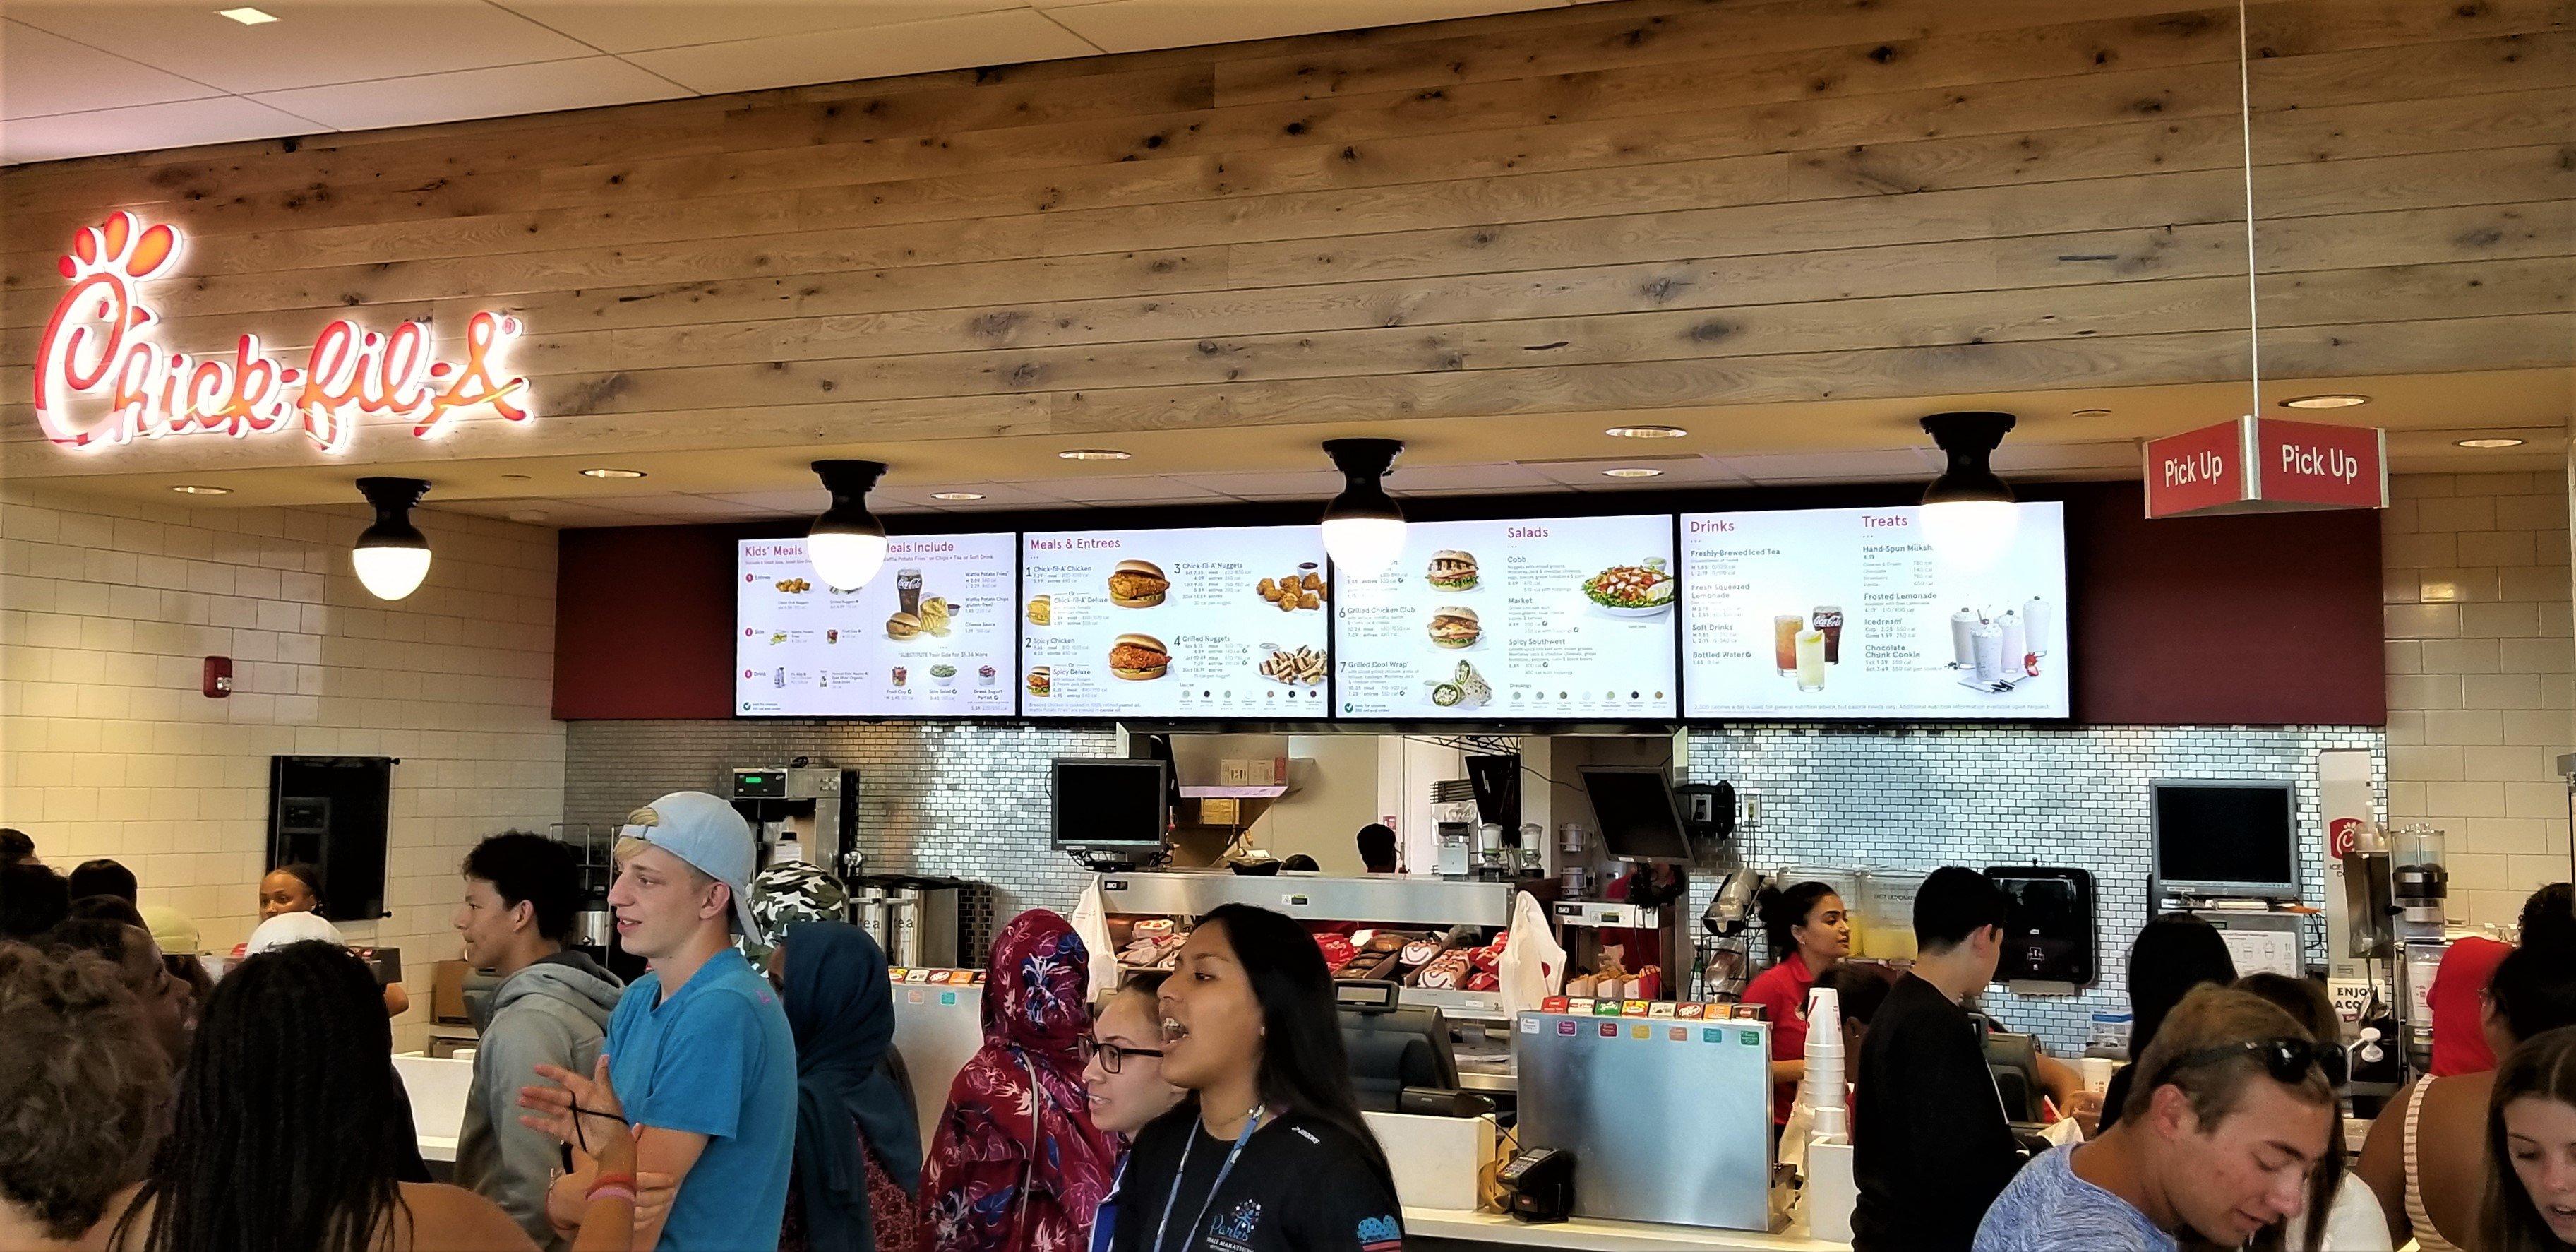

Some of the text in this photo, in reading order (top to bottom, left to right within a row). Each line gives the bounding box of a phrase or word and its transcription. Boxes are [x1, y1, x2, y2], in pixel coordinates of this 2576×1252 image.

[34, 210, 534, 452] Chick-fil-A
[2165, 451, 2222, 487] Pick Up
[2282, 444, 2358, 484] Pick Up
[1691, 520, 1735, 532] Drinks
[1862, 515, 1908, 527] Treats
[1508, 527, 1548, 538] Salads
[887, 542, 954, 553] eals Include
[1031, 538, 1120, 549] Meals & Entrees
[774, 545, 803, 556] Meals
[1026, 567, 1032, 577] 1
[1174, 564, 1180, 573] 3
[1339, 607, 1346, 618] 6
[1026, 638, 1031, 648] 2
[1174, 636, 1180, 646] 4
[1340, 662, 1346, 673] 7
[2335, 1001, 2343, 1009] A
[1209, 1213, 1249, 1241] Parks
